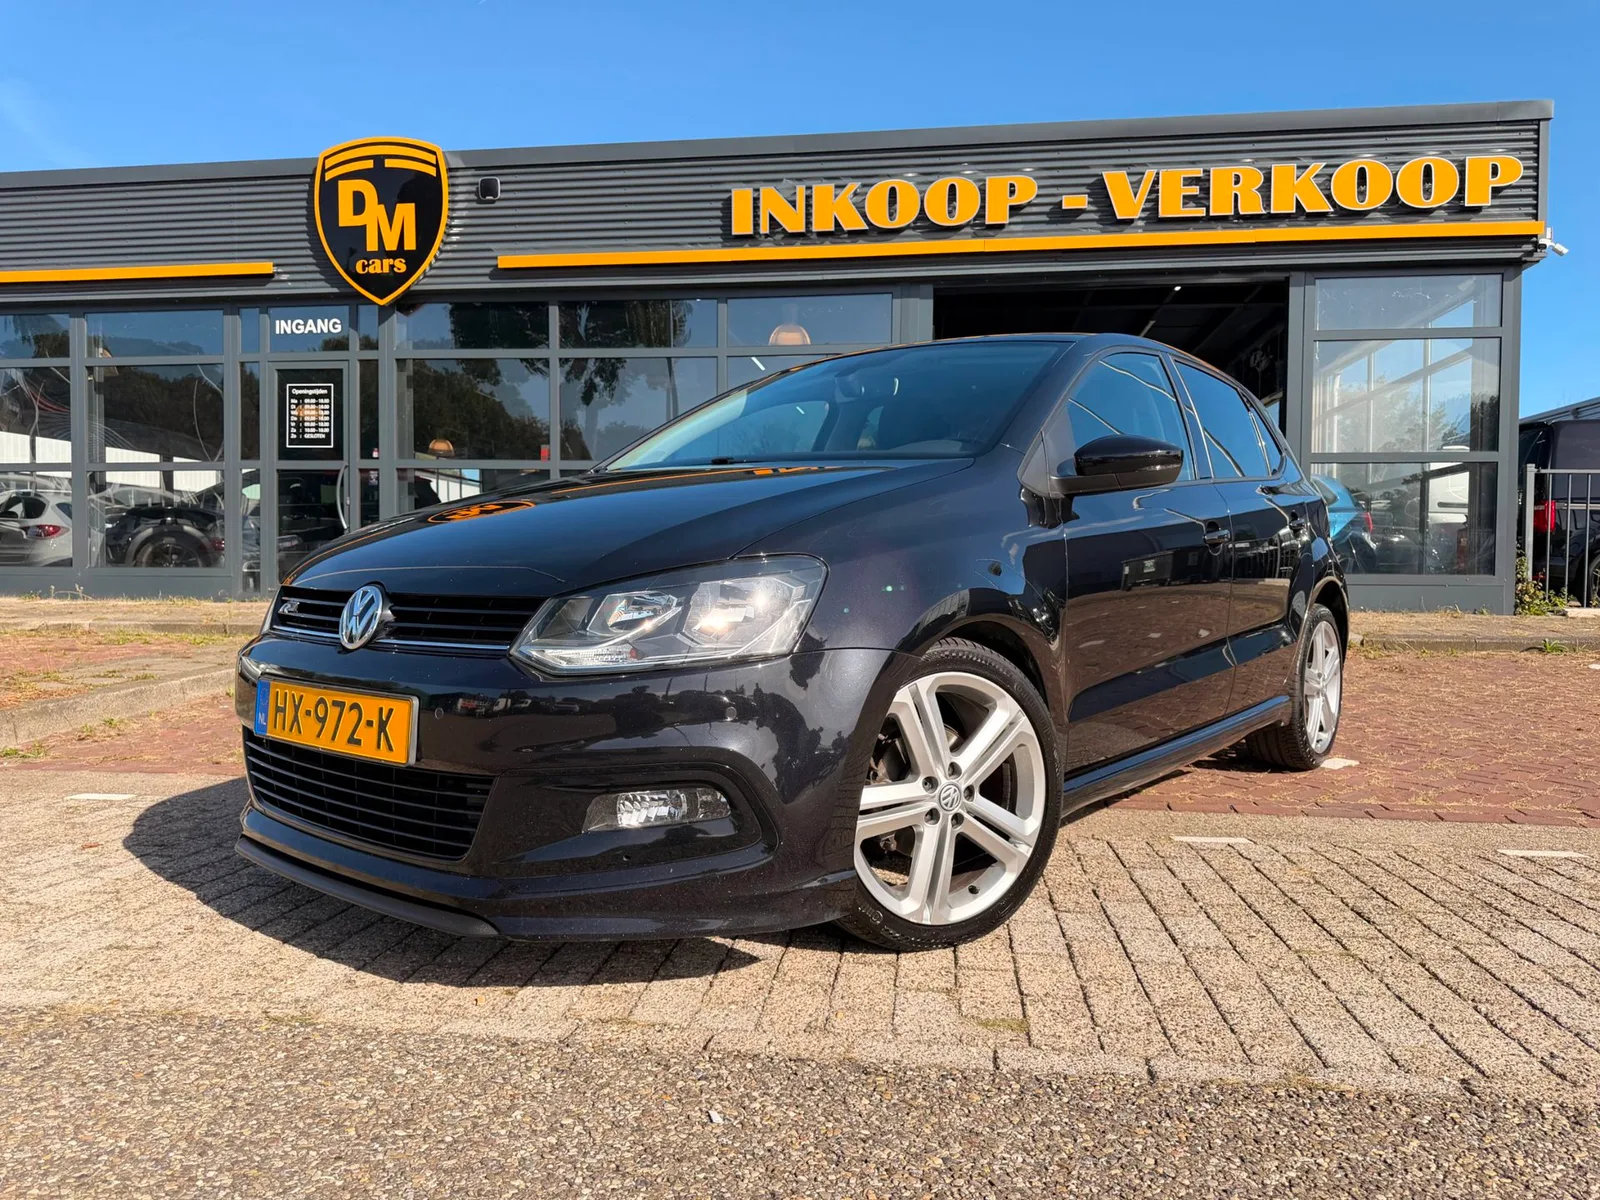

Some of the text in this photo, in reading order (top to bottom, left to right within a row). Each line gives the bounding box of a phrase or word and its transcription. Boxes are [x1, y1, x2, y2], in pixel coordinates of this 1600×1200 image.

[731, 155, 1524, 236] INKOOP - VERKOOP
[337, 179, 417, 252] DM
[355, 257, 407, 275] cars
[275, 318, 342, 335] INGANG
[291, 388, 328, 396] Openingstijden
[258, 712, 267, 726] NL
[273, 688, 395, 752] HX-972-K
